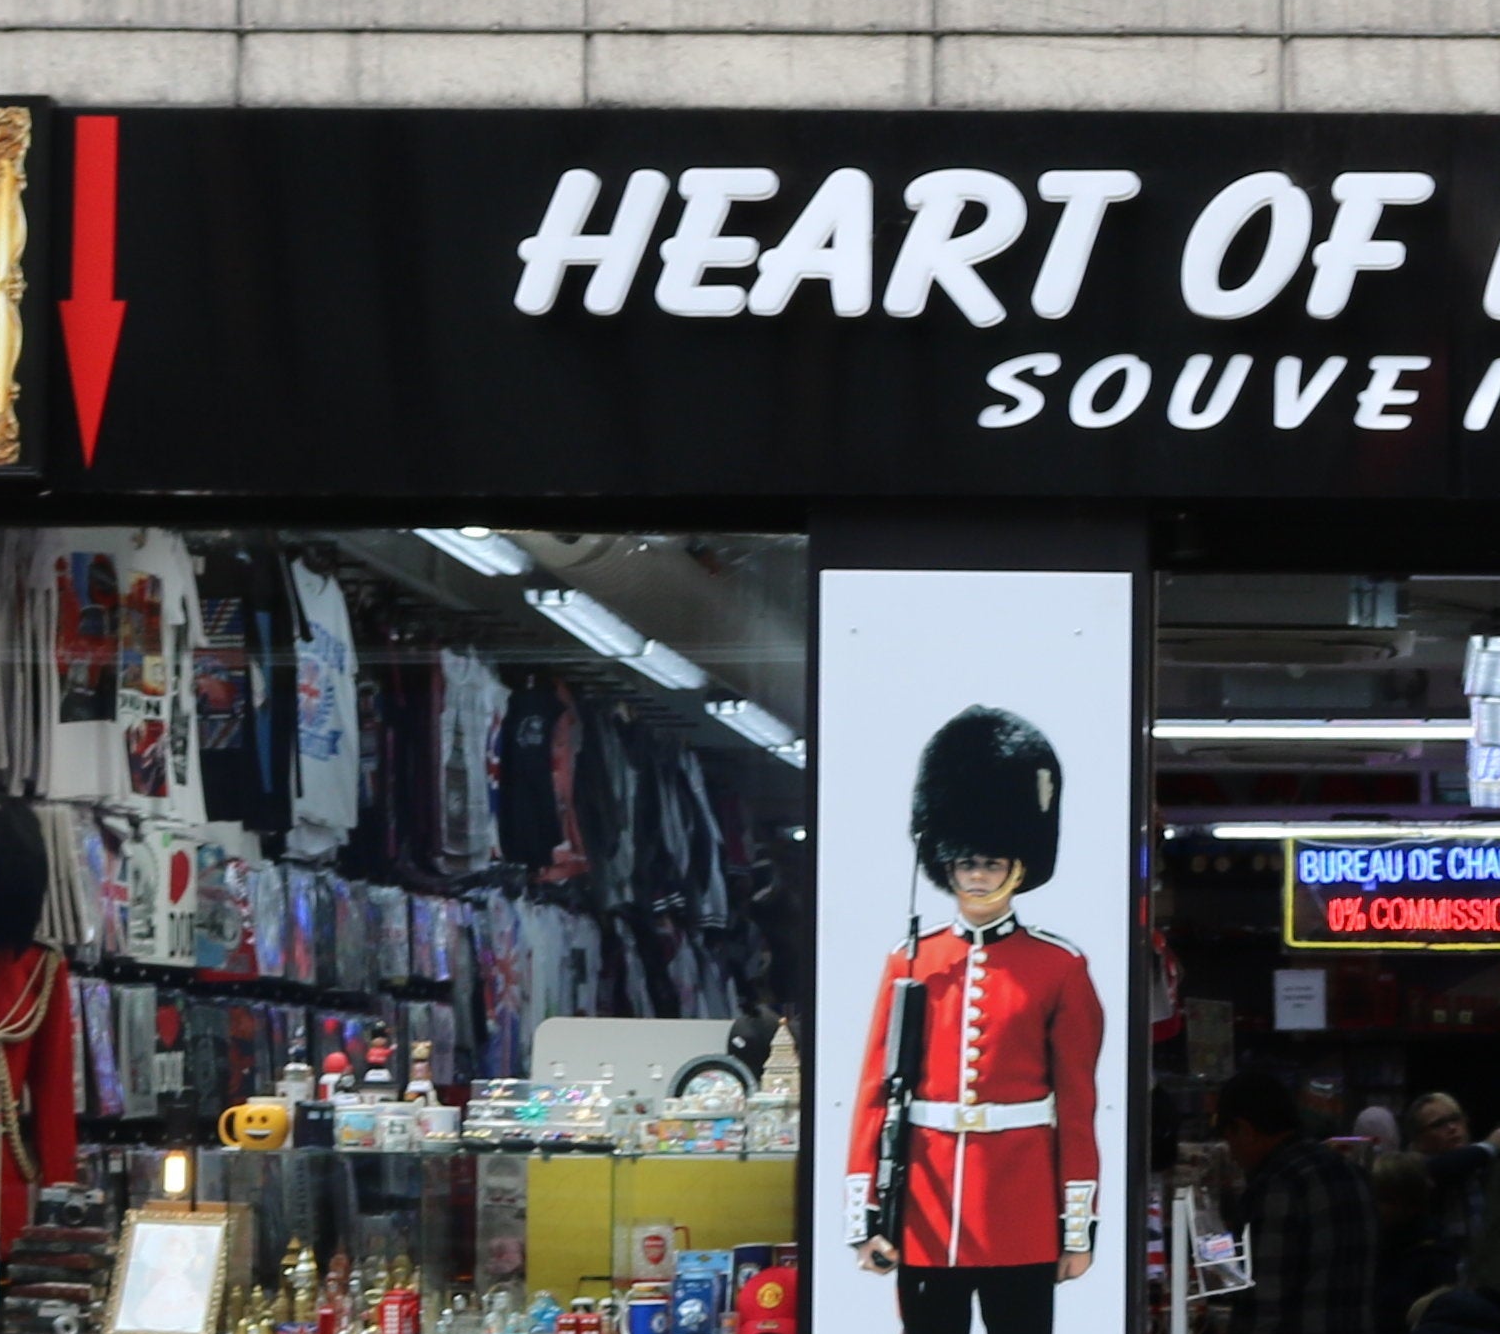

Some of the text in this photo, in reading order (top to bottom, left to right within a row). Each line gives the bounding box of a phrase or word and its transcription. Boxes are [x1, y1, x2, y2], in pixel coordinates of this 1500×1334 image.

[515, 168, 1141, 327] HEART
[1181, 172, 1435, 319] OF
[1299, 849, 1404, 884] BUREAU
[1407, 847, 1444, 881] DE
[1328, 896, 1368, 932] 0%
